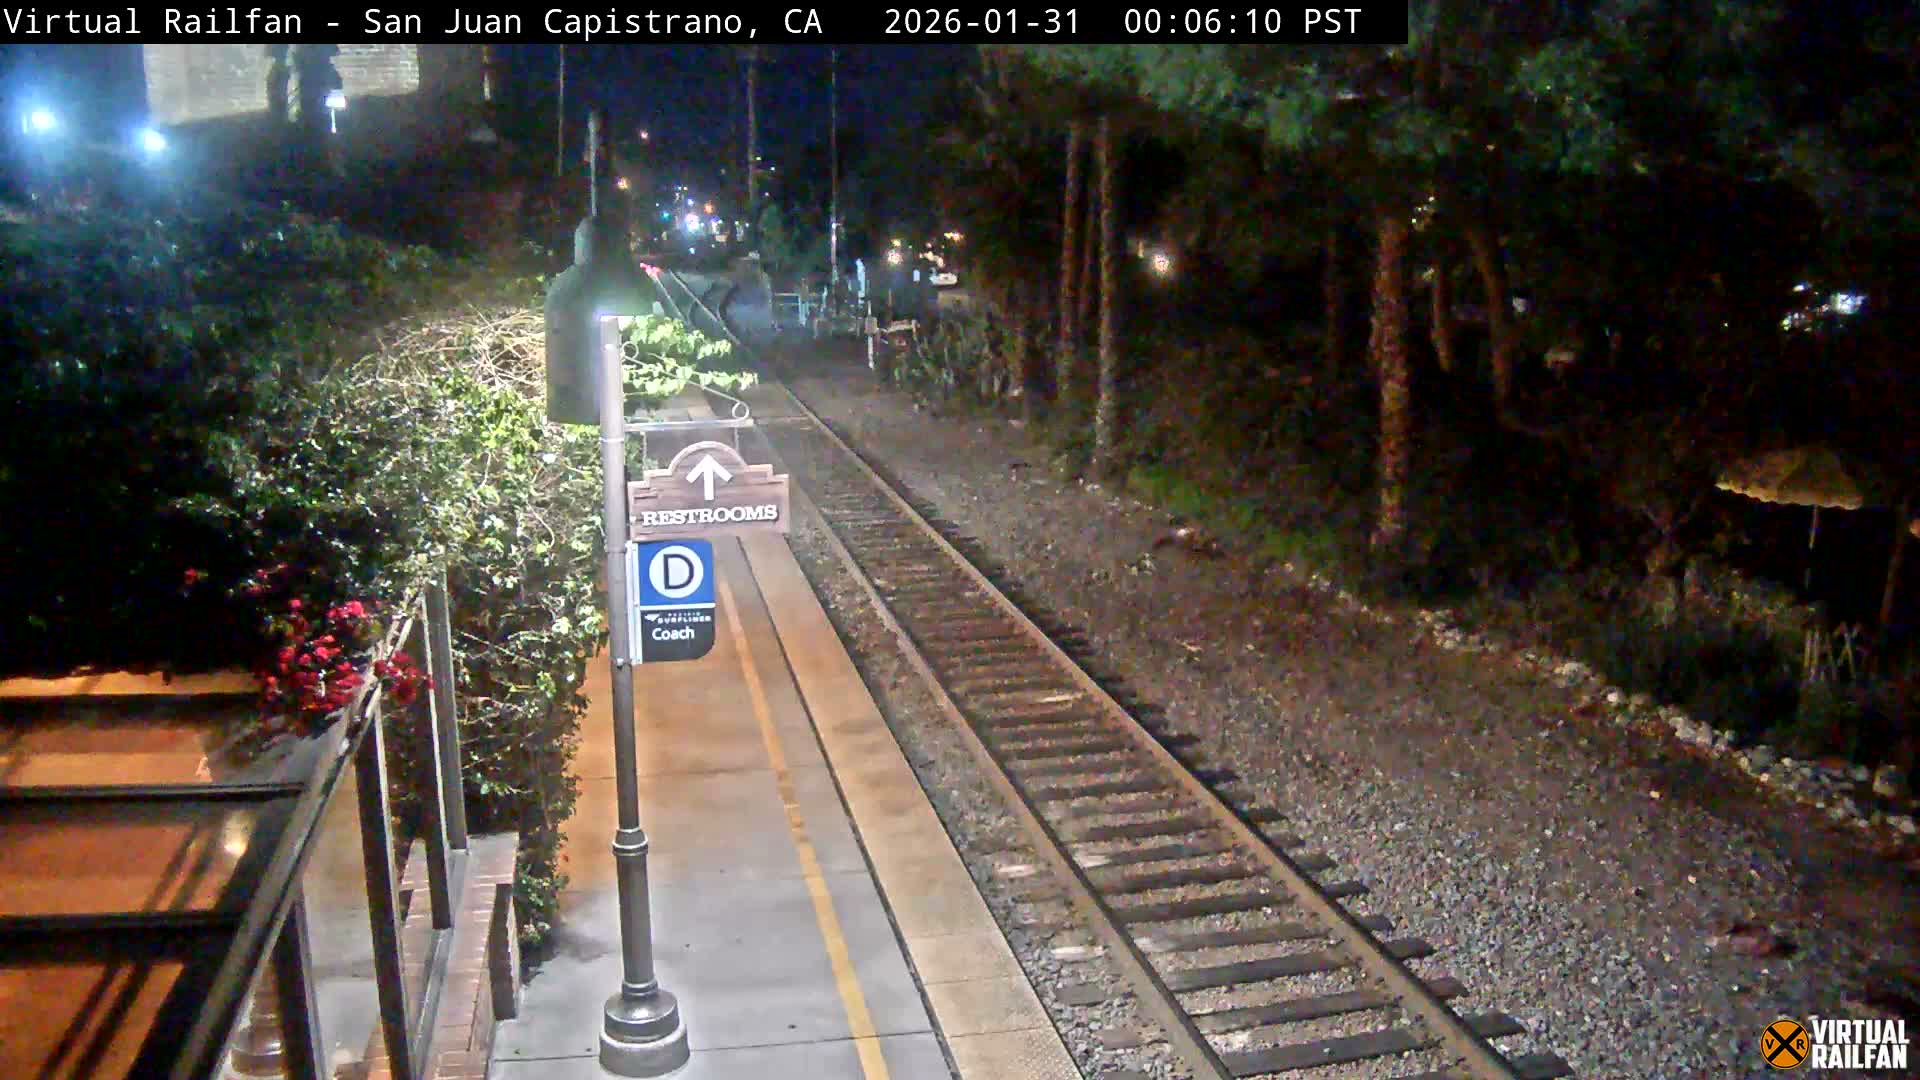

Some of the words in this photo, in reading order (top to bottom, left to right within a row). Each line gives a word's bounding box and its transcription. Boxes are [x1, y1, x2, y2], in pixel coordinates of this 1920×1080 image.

[641, 505, 778, 526] RESTROOMS
[663, 553, 694, 589] D
[657, 615, 711, 624] URFLINE
[652, 626, 695, 640] Coach
